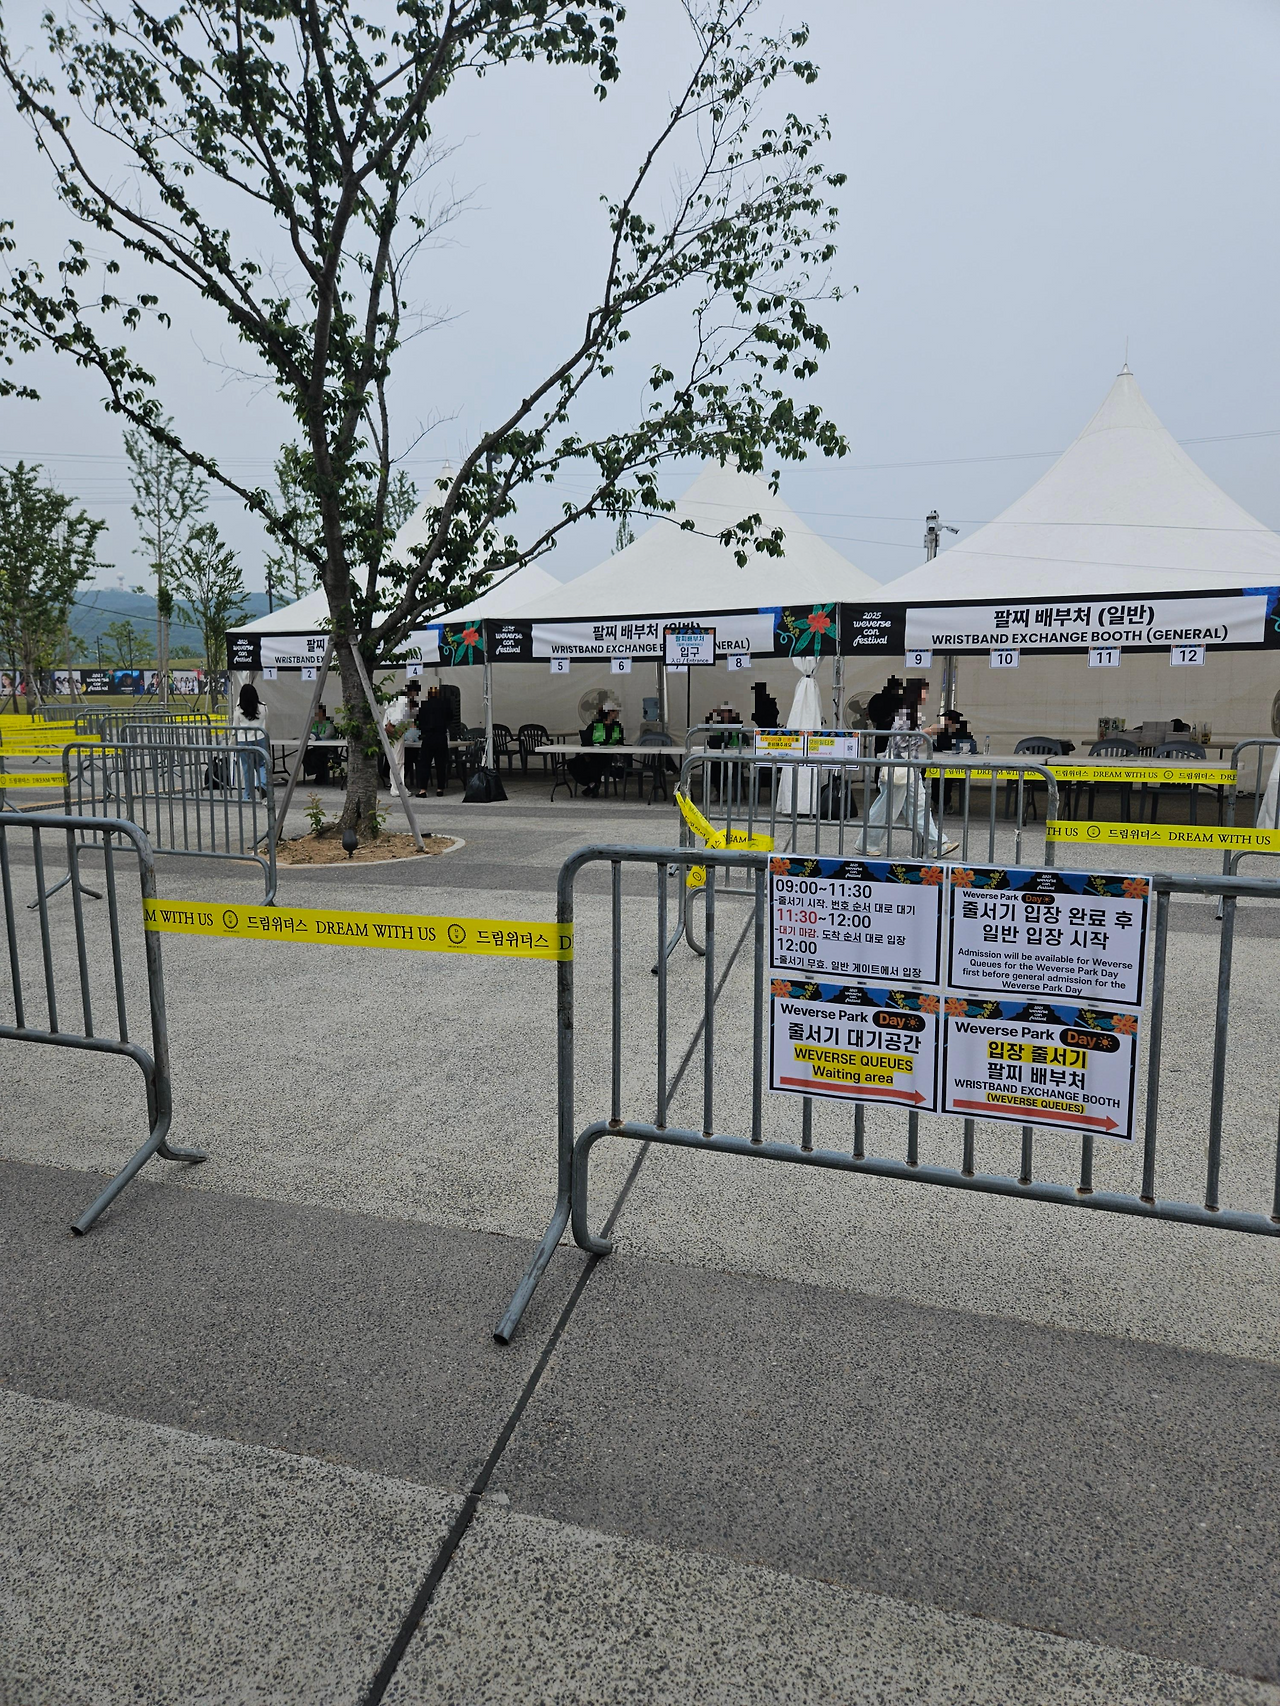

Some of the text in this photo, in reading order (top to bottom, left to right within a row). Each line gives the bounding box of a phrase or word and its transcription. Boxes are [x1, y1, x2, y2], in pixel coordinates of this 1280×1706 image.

[853, 620, 892, 628] weverse
[994, 604, 1155, 629] 팔찌 배부처 (일반)
[593, 625, 617, 640] 팔찌
[621, 623, 659, 639] 배부처
[863, 628, 879, 636] con
[932, 625, 1228, 645] WRISTBAND EXCHANGE BOOTH (GENERAL)
[307, 639, 324, 652] 팔찌
[606, 644, 657, 653] EXCHANGE
[853, 636, 887, 646] festival
[680, 647, 699, 657] 입구
[915, 654, 922, 664] 9
[998, 653, 1013, 664] 10
[1097, 652, 1112, 663] 11
[1180, 650, 1197, 662] 12
[558, 662, 563, 670] 5
[619, 661, 624, 670] 6
[736, 658, 742, 667] 8
[307, 670, 311, 678] 2
[413, 667, 418, 675] 4
[1124, 771, 1146, 779] WITH
[1148, 771, 1158, 779] US
[1065, 828, 1078, 836] US
[1169, 832, 1213, 843] DREAM
[1218, 834, 1252, 844] WITH
[1256, 835, 1271, 844] US
[776, 879, 872, 898] 09:00~11:30
[963, 891, 998, 900] Weverse
[1025, 895, 1043, 904] Day
[831, 900, 850, 910] 번호
[852, 902, 871, 912] 순서
[875, 904, 893, 913] 대로
[897, 904, 915, 915] 대기
[962, 901, 1132, 929] 줄서기 입장 완료 후
[160, 910, 194, 925] WITH
[198, 913, 213, 926] US
[316, 920, 369, 937] DREAM
[373, 924, 413, 940] WITH
[418, 927, 436, 941] US
[777, 908, 871, 928] 11:30~12:00
[822, 930, 841, 940] 도착
[843, 932, 862, 943] 순서
[865, 934, 883, 944] 대로
[887, 935, 906, 945] 입장
[983, 925, 1109, 950] 일반 입장 시작
[777, 938, 817, 954] 12:00
[958, 948, 1001, 958] Admission
[1035, 954, 1074, 963] available
[1077, 956, 1089, 964] for
[1092, 958, 1132, 969] Weverse
[831, 961, 849, 972] 일반
[852, 963, 898, 976] 게이트에서
[903, 968, 921, 977] 입장
[970, 959, 1001, 968] Queues
[1004, 961, 1017, 969] for
[1036, 964, 1075, 974] Weverse
[1078, 967, 1098, 976] Park
[1101, 969, 1118, 979] Day
[963, 968, 1125, 989] first before general admission for the
[1002, 981, 1082, 995] Weverse Park Day
[781, 1003, 906, 1028] Weverse Park Day
[789, 1022, 921, 1054] 줄서기 대기공간
[955, 1022, 1096, 1048] Weverse Park Day
[794, 1047, 913, 1071] WEVERSE QUEUES
[988, 1042, 1087, 1069] 입장 줄서기
[813, 1065, 893, 1084] Waiting area
[988, 1062, 1085, 1090] 팔찌 배부처
[954, 1079, 1120, 1108] WRISTBAND EXCHANGE BOOTH
[987, 1093, 1084, 1113] (WEVERSE QUEUES)
